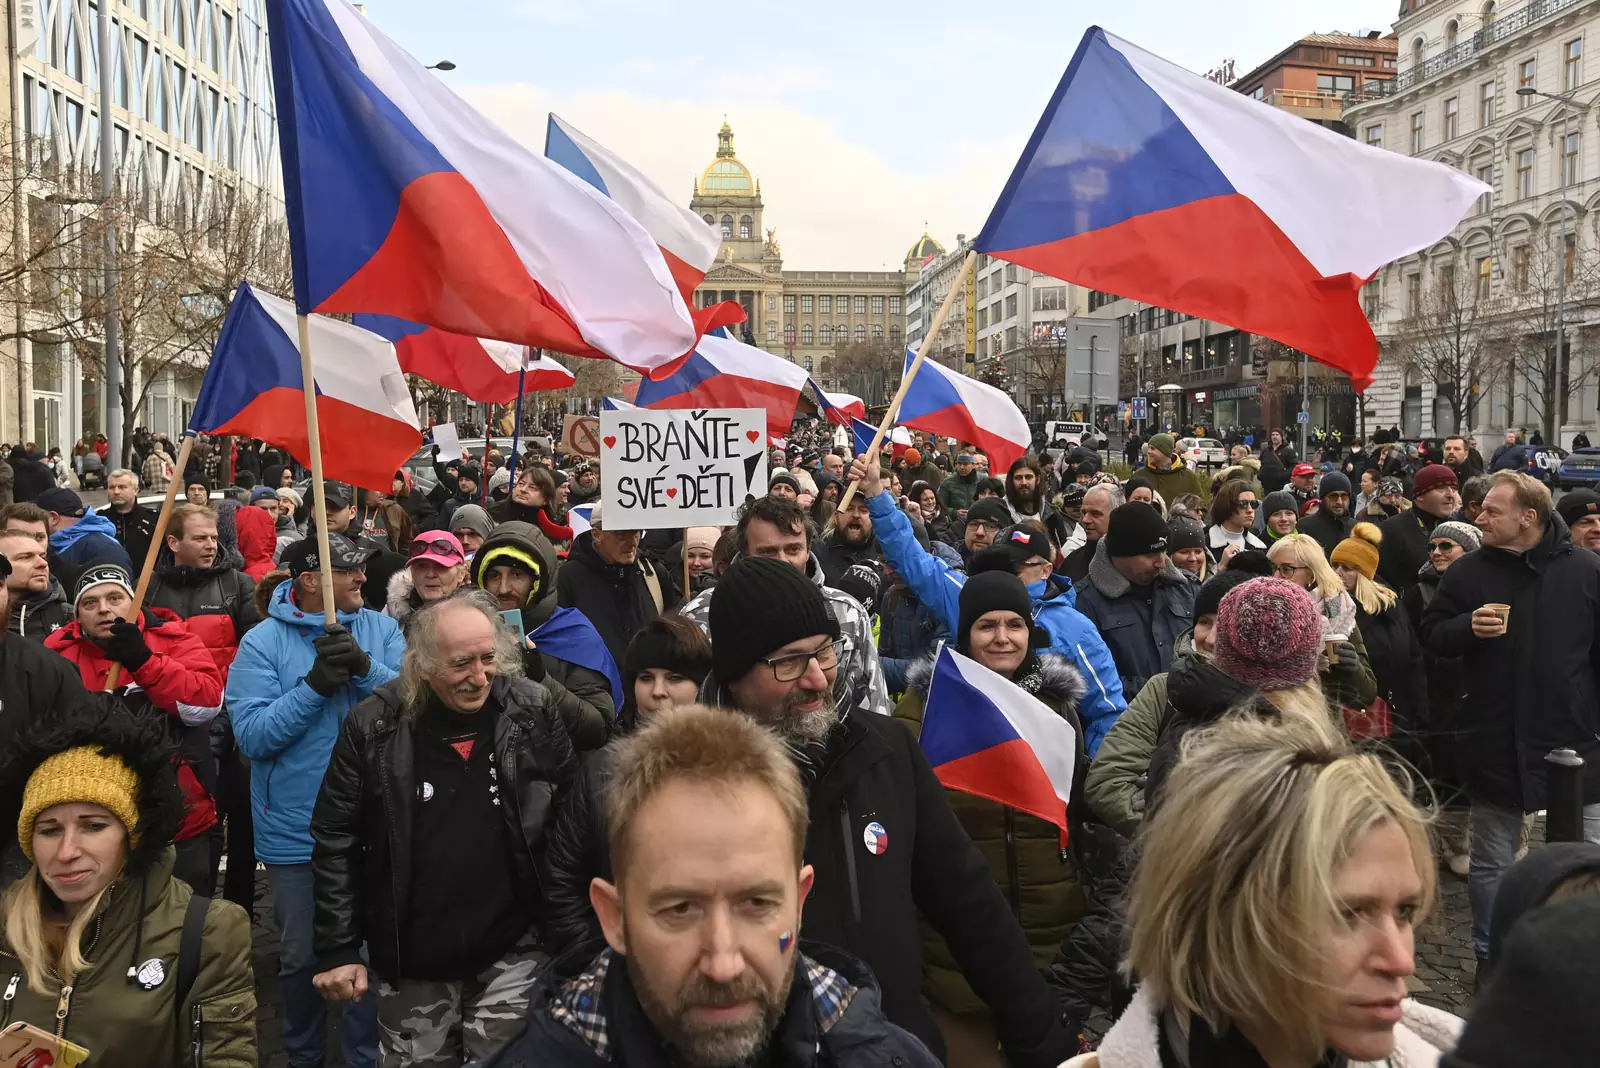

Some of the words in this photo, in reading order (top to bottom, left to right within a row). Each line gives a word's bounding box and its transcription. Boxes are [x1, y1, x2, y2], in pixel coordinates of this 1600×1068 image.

[20, 0, 34, 29] RK
[619, 409, 741, 462] BRAŇTE
[617, 464, 667, 509] SVÉ
